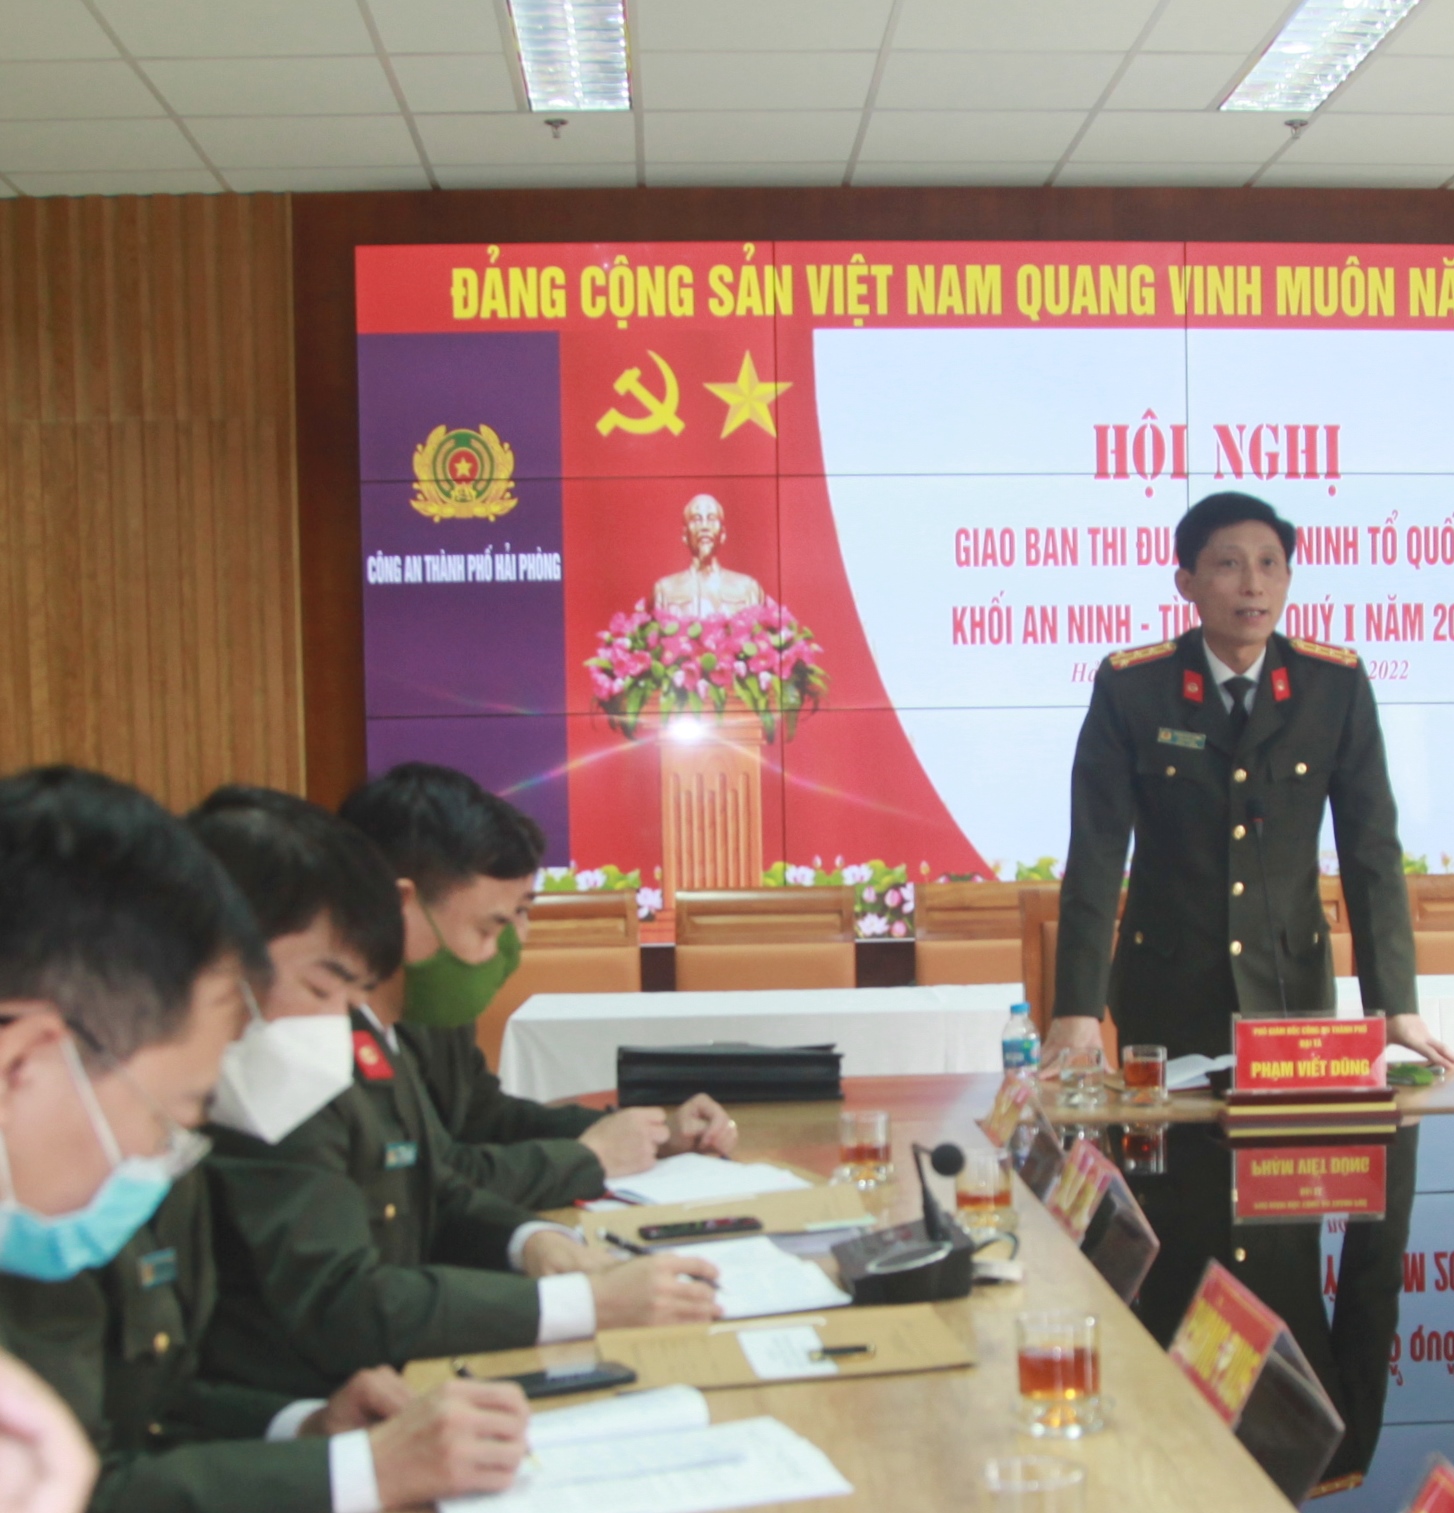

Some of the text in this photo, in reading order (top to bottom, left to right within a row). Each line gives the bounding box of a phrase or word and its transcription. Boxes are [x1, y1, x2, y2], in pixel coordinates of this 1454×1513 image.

[451, 245, 567, 320] ĐẢNG
[580, 255, 695, 328] CỘNG
[708, 243, 794, 318] SẢN
[806, 254, 894, 327] VIỆT
[907, 265, 1003, 316] NAM
[1017, 265, 1156, 321] QUANG
[1169, 266, 1263, 317] VINH
[1276, 256, 1397, 318] MUÔN
[1094, 409, 1341, 498] HỘI NGHỊ
[367, 542, 562, 584] CÔNG AN THÀNH PHỐ HẢI PHÒNG
[955, 528, 1016, 568] GIAO
[1025, 527, 1079, 567] BAN
[1088, 527, 1127, 567] THI
[1295, 527, 1359, 566] NINH
[1368, 509, 1398, 566] TỔ
[952, 591, 1013, 645] KHỐI
[1022, 606, 1058, 644] AN
[1068, 605, 1131, 644] NINH
[1285, 594, 1335, 643] QUÝ
[1344, 604, 1356, 642] I
[1365, 594, 1424, 642] NĂM
[1368, 660, 1410, 681] 2022
[1251, 1055, 1370, 1081] PHẠM VIẾT DŨNG
